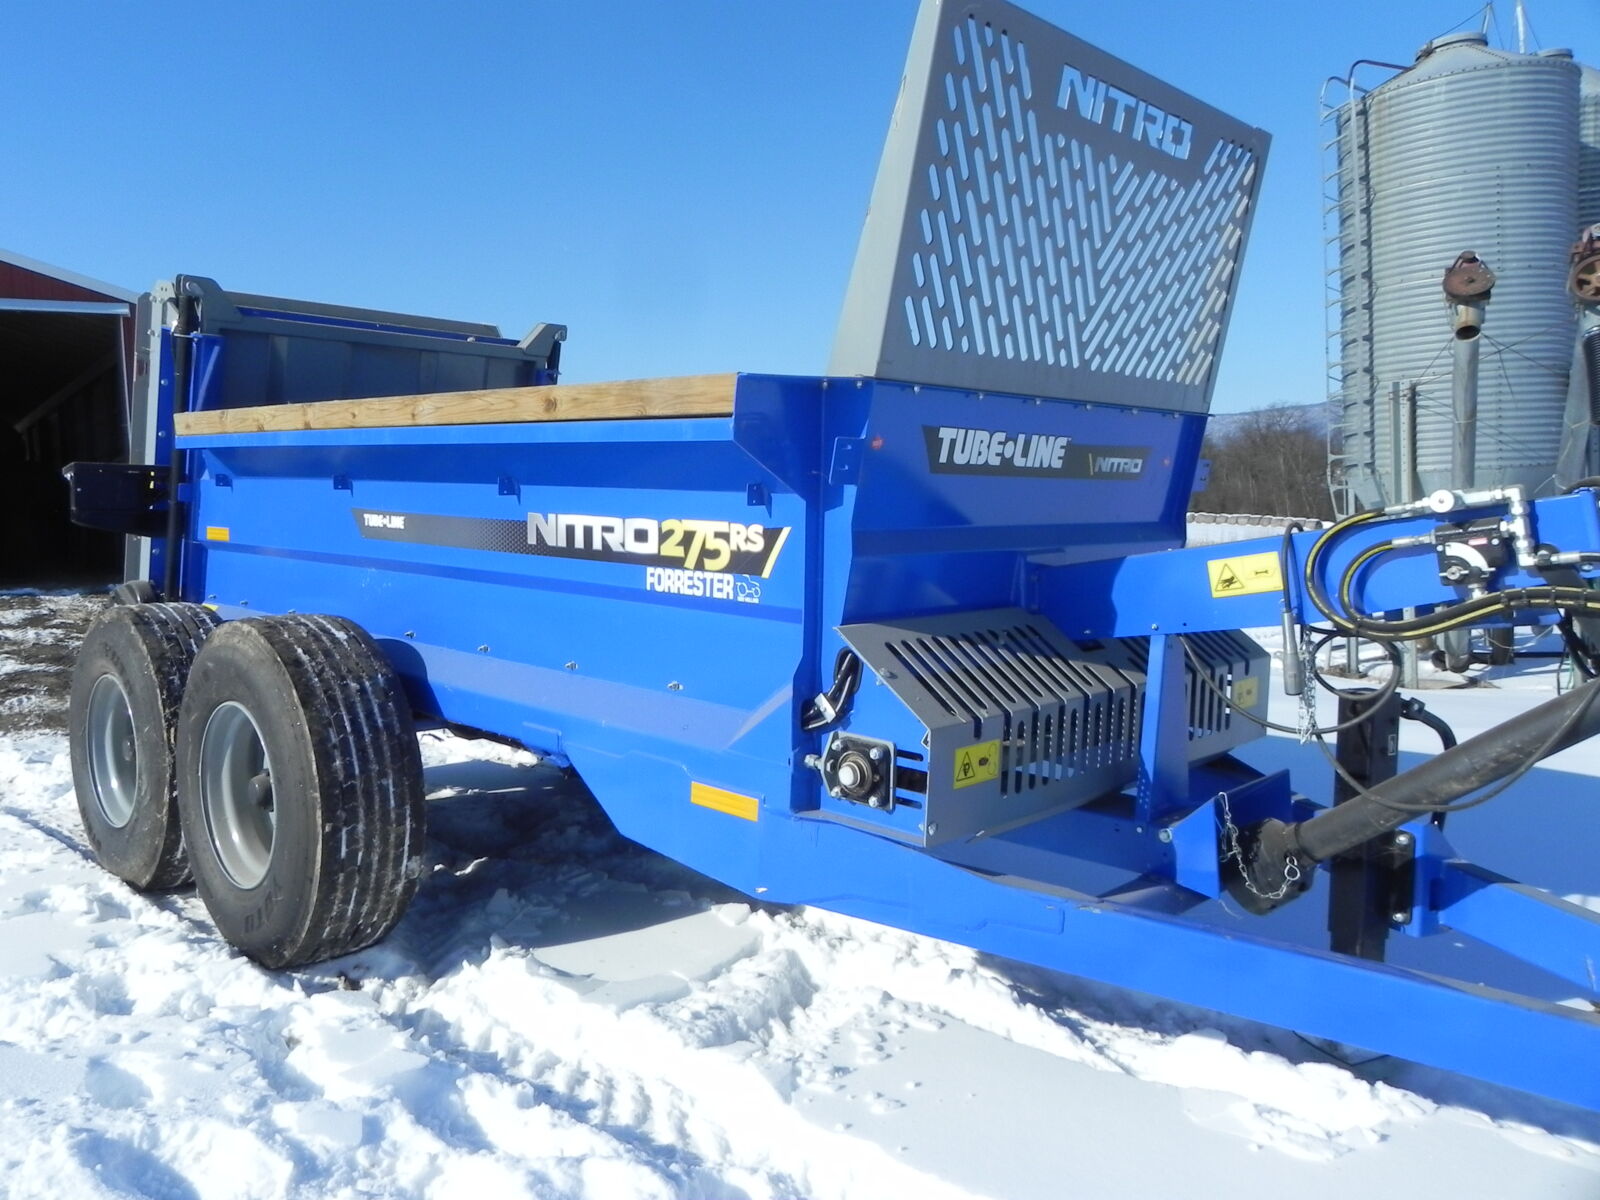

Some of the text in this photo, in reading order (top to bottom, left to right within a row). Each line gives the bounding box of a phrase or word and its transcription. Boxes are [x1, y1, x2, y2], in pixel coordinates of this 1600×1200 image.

[1057, 63, 1193, 160] NITRO
[1094, 456, 1143, 473] NITRO
[527, 512, 659, 554] NITRO
[646, 566, 735, 600] FORRESTER
